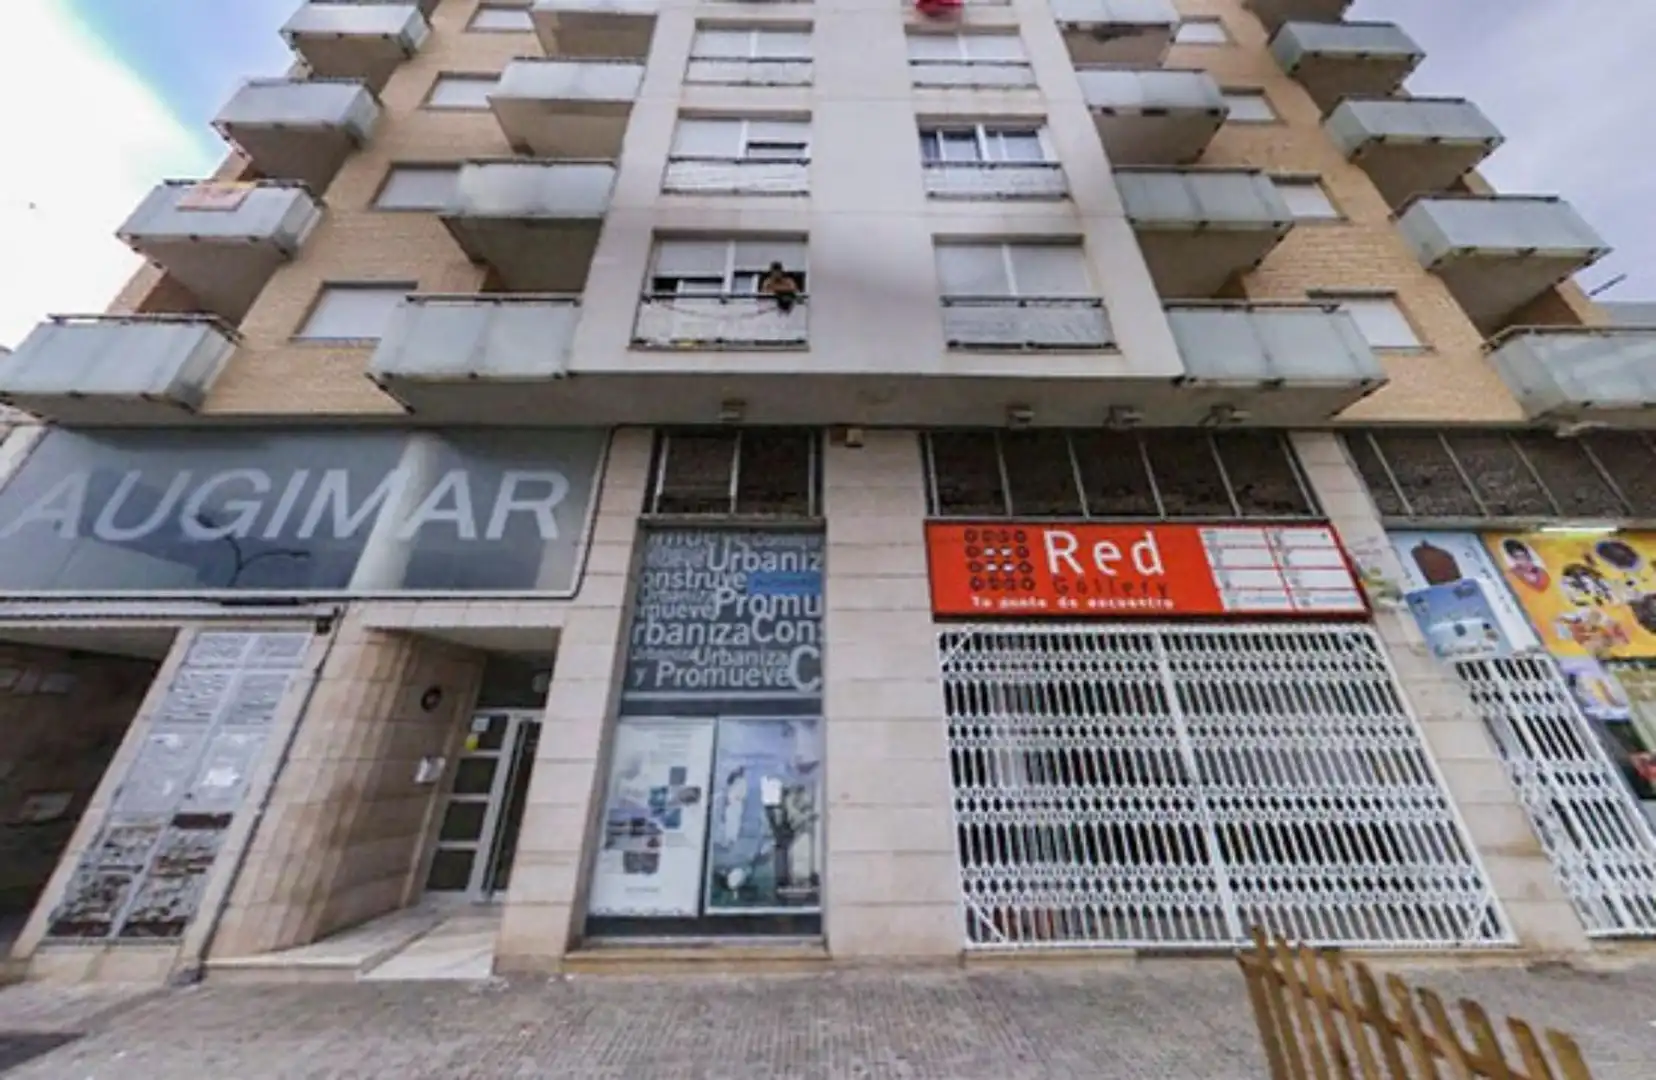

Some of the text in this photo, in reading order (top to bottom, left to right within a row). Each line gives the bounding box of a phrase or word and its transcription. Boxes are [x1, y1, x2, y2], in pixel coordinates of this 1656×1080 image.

[2, 467, 570, 541] AUGIMAR
[1043, 528, 1165, 576] Red
[1057, 596, 1078, 609] de
[654, 661, 794, 688] Promueve
